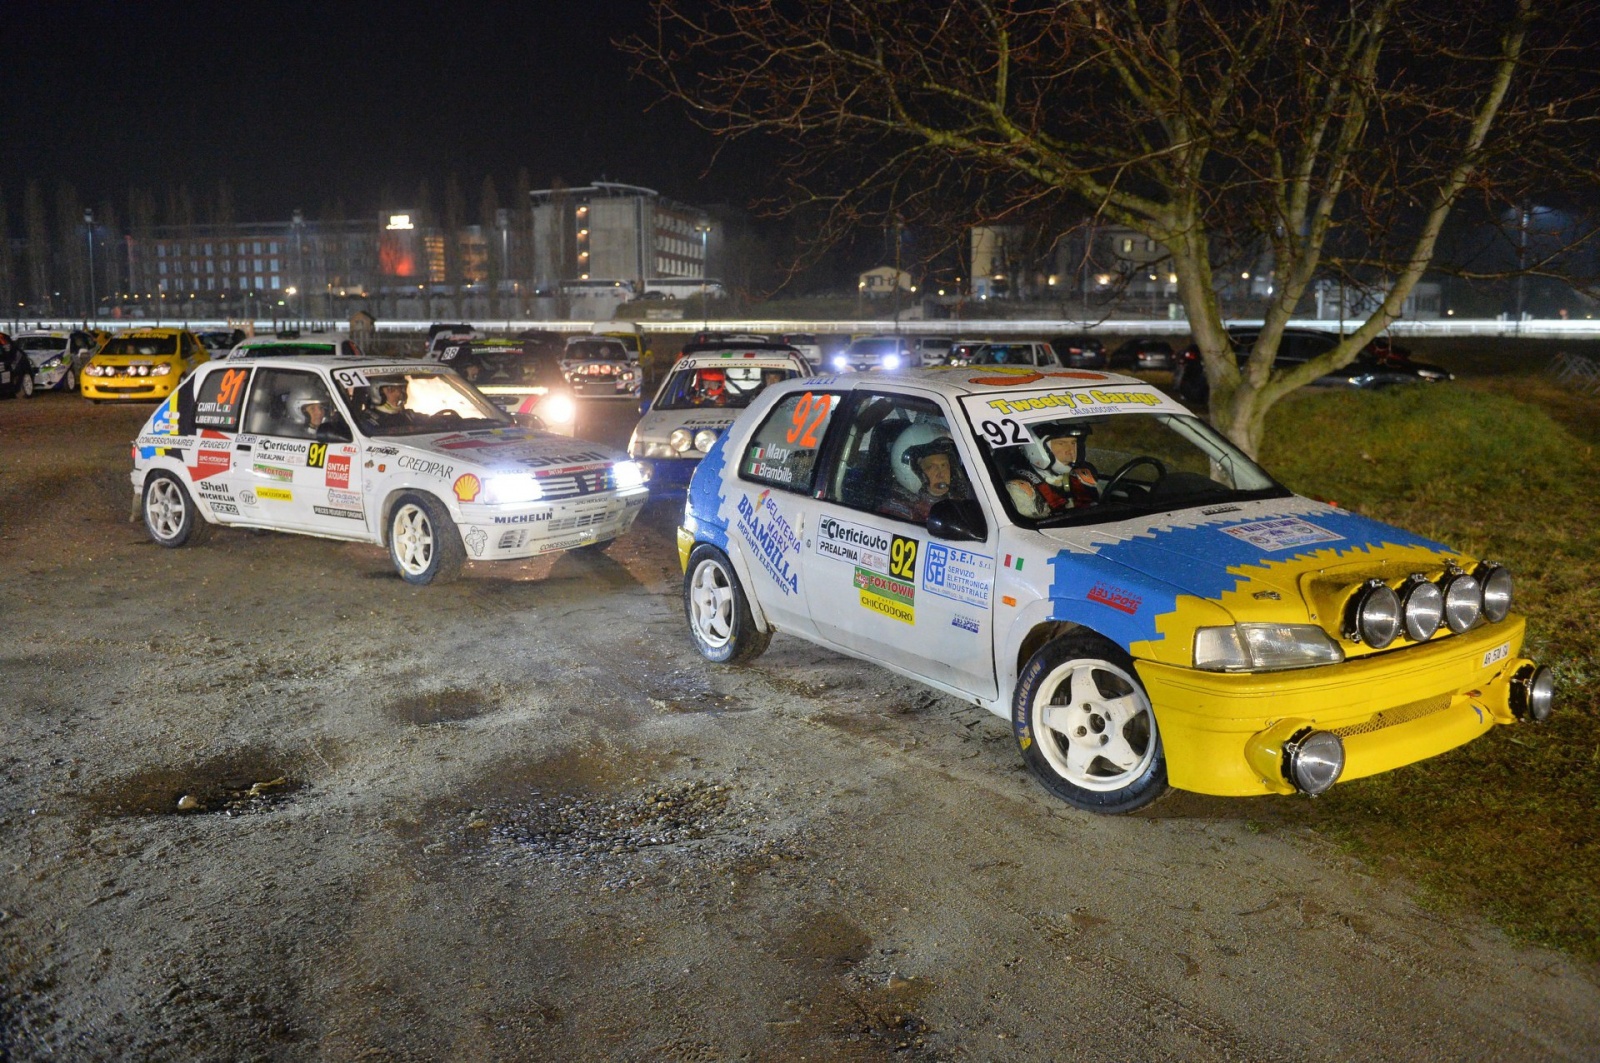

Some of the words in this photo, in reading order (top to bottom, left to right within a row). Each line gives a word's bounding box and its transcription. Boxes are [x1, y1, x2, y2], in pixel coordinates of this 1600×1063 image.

[679, 359, 697, 370] 90
[217, 368, 247, 405] 91
[339, 371, 365, 386] 91
[987, 391, 1093, 415] Tweety's
[1089, 389, 1163, 406] Garage
[786, 391, 832, 449] 92
[981, 417, 1031, 446] 92
[198, 439, 232, 449] PEUGEOT
[263, 439, 307, 454] Clericiauto
[342, 444, 357, 454] BELL
[766, 442, 791, 464] Mary
[256, 452, 285, 462] PREALPINA
[309, 443, 326, 467] 91
[517, 451, 611, 468] Shell
[327, 462, 350, 472] SNTAF
[398, 454, 454, 479] CREDIPAR
[758, 463, 793, 483] Brambilla
[200, 481, 229, 493] Shell
[198, 492, 236, 503] MICHELIN
[494, 512, 553, 524] MICHELIN
[766, 497, 802, 554] GELATERIA
[736, 519, 760, 557] IMPIANTI
[737, 493, 799, 595] BRAMBILLA
[767, 521, 790, 553] MARY
[827, 518, 888, 551] Clericiauto
[820, 541, 858, 561] PREALPINA
[890, 538, 917, 580] 92
[950, 550, 976, 566] S.E.I.
[947, 565, 975, 579] SERVIZIO
[946, 581, 988, 600] INDUSTRIALE
[947, 573, 989, 592] ELETTRONICA
[1017, 661, 1042, 724] MICHELIN
